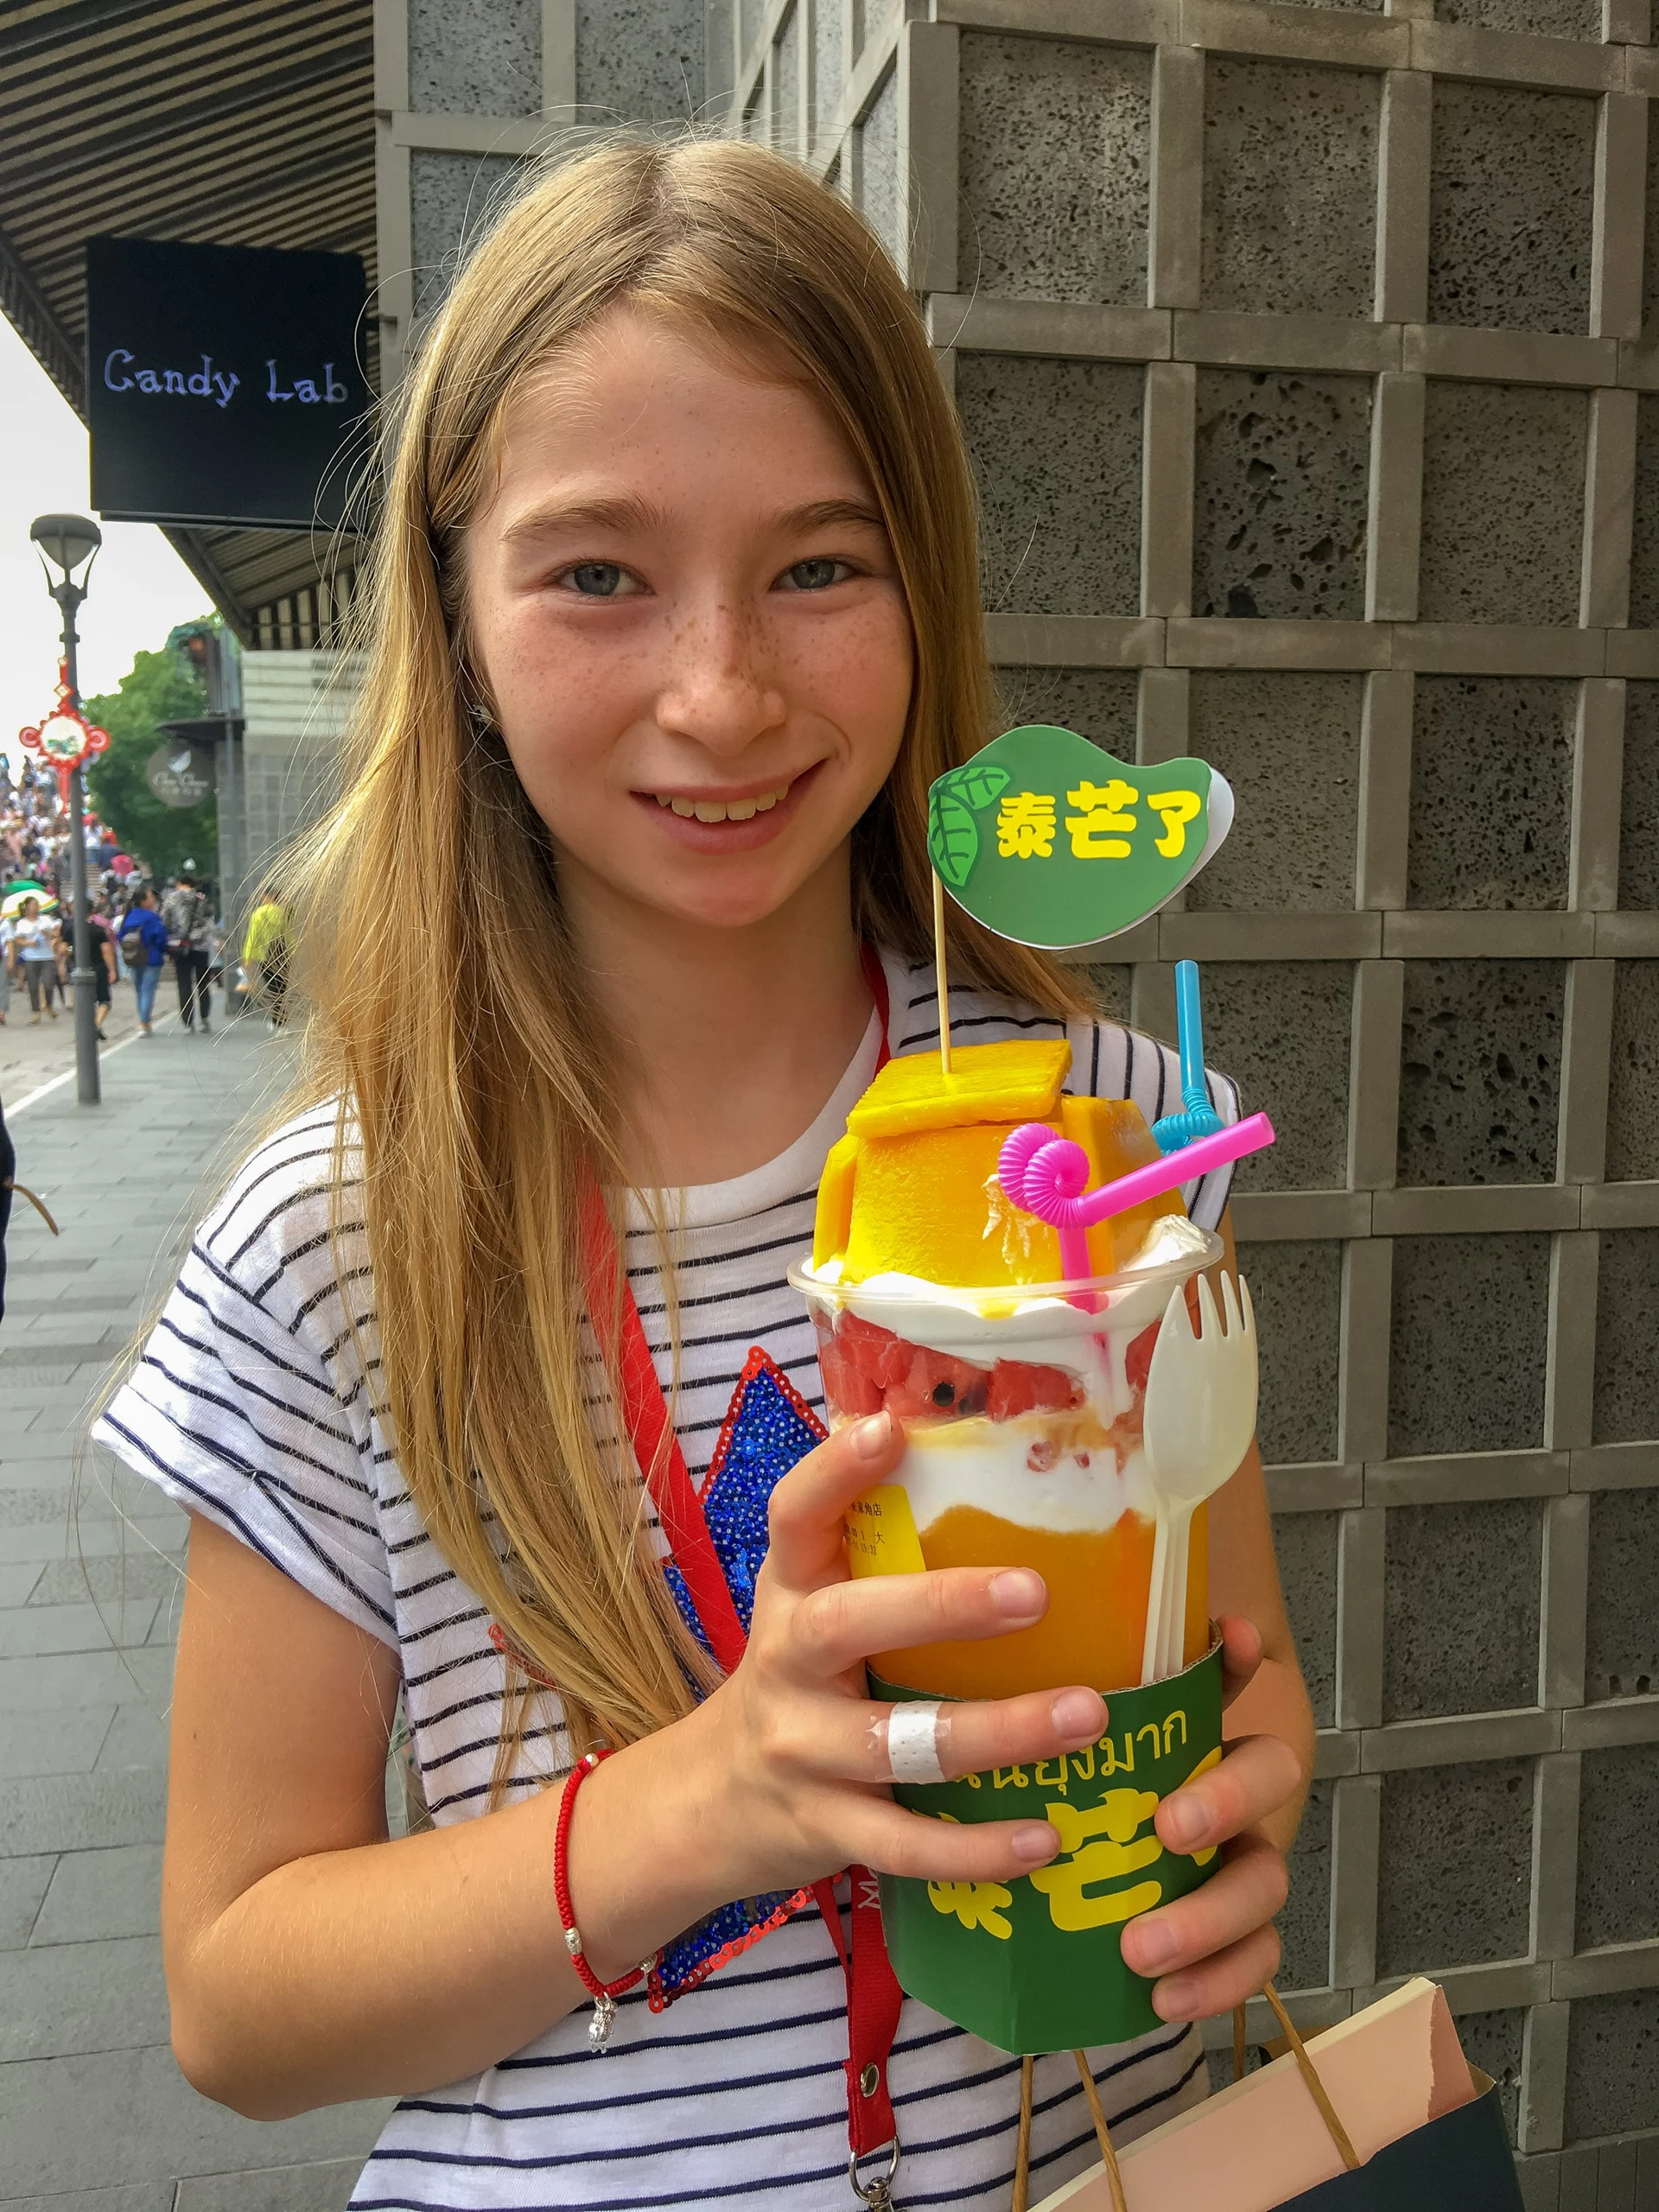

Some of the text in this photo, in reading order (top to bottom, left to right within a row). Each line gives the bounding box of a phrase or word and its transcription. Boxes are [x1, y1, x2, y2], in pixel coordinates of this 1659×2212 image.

[104, 348, 349, 409] Candy Lab
[995, 779, 1202, 860] 泰芒了
